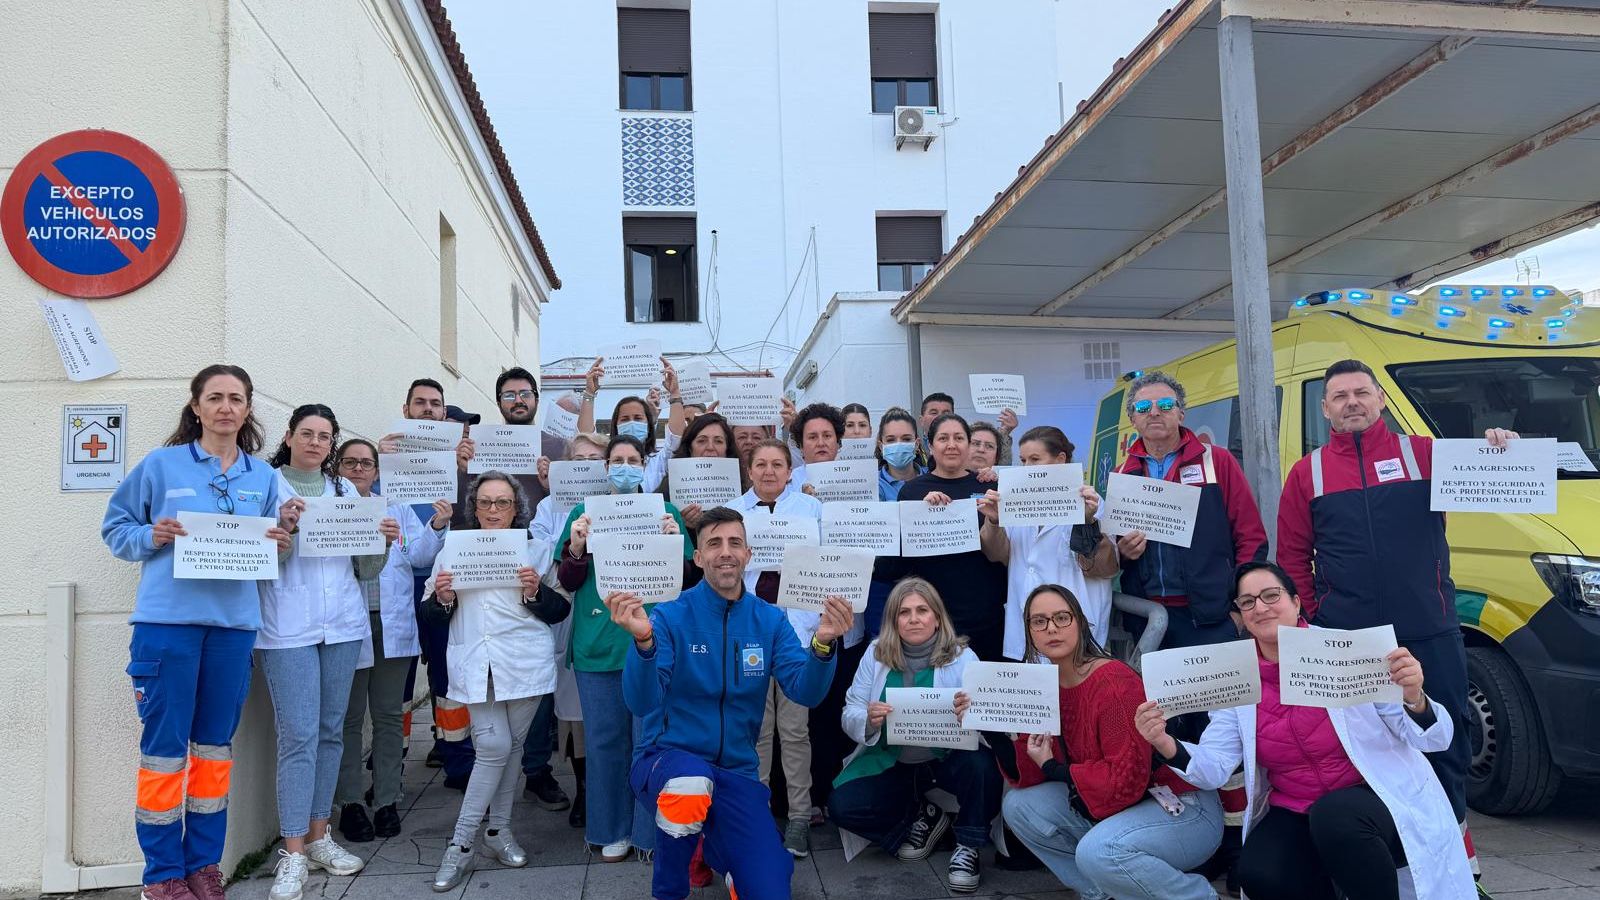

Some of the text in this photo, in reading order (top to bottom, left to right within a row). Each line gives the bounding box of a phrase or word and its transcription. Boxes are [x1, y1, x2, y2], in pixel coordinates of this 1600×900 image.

[50, 186, 134, 200] EXCEPTO
[40, 206, 144, 220] VEHICULOS
[26, 226, 156, 240] AUTORIZADOS
[84, 327, 98, 345] STOP
[1142, 485, 1164, 493] STOP
[1140, 500, 1182, 511] AGRESIONES
[1112, 509, 1140, 517] RESPETO
[1146, 514, 1181, 524] SEGURIDAD
[1119, 523, 1144, 531] CENTRO
[1324, 639, 1352, 649] STOP
[1183, 656, 1210, 666] STOP
[1326, 658, 1382, 666] AGRESIONES
[1170, 678, 1186, 686] LAS
[1188, 670, 1240, 684] AGRESIONES
[1291, 672, 1328, 681] RESPETO
[1336, 672, 1383, 682] SEGURIDAD
[1157, 693, 1192, 704] RESPETO
[1200, 684, 1243, 696] SEGURIDAD
[1304, 690, 1338, 698] CENTRO
[1352, 687, 1378, 696] SALUD
